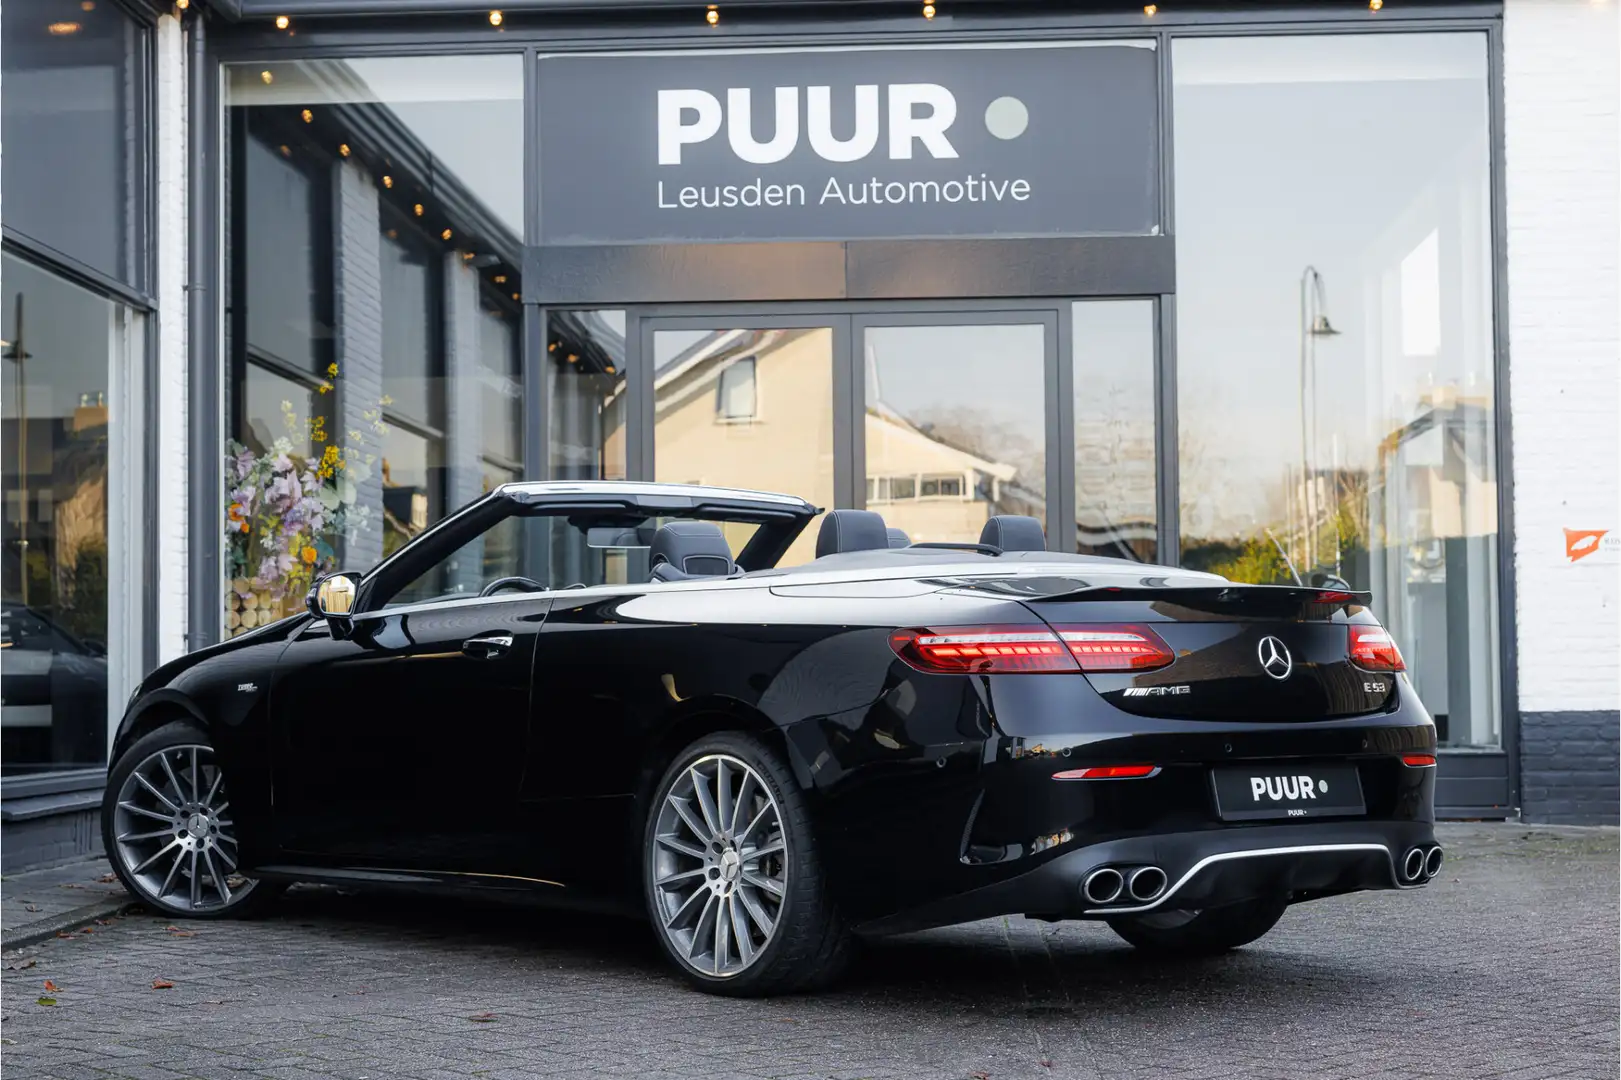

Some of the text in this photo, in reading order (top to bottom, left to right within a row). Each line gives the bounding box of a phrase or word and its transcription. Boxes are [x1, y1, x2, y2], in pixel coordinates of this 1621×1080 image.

[657, 83, 960, 165] PUUR
[658, 173, 1031, 208] Leusden Automotive
[1144, 685, 1191, 696] AMG
[1363, 682, 1386, 692] E 53
[1250, 775, 1317, 801] PUUR
